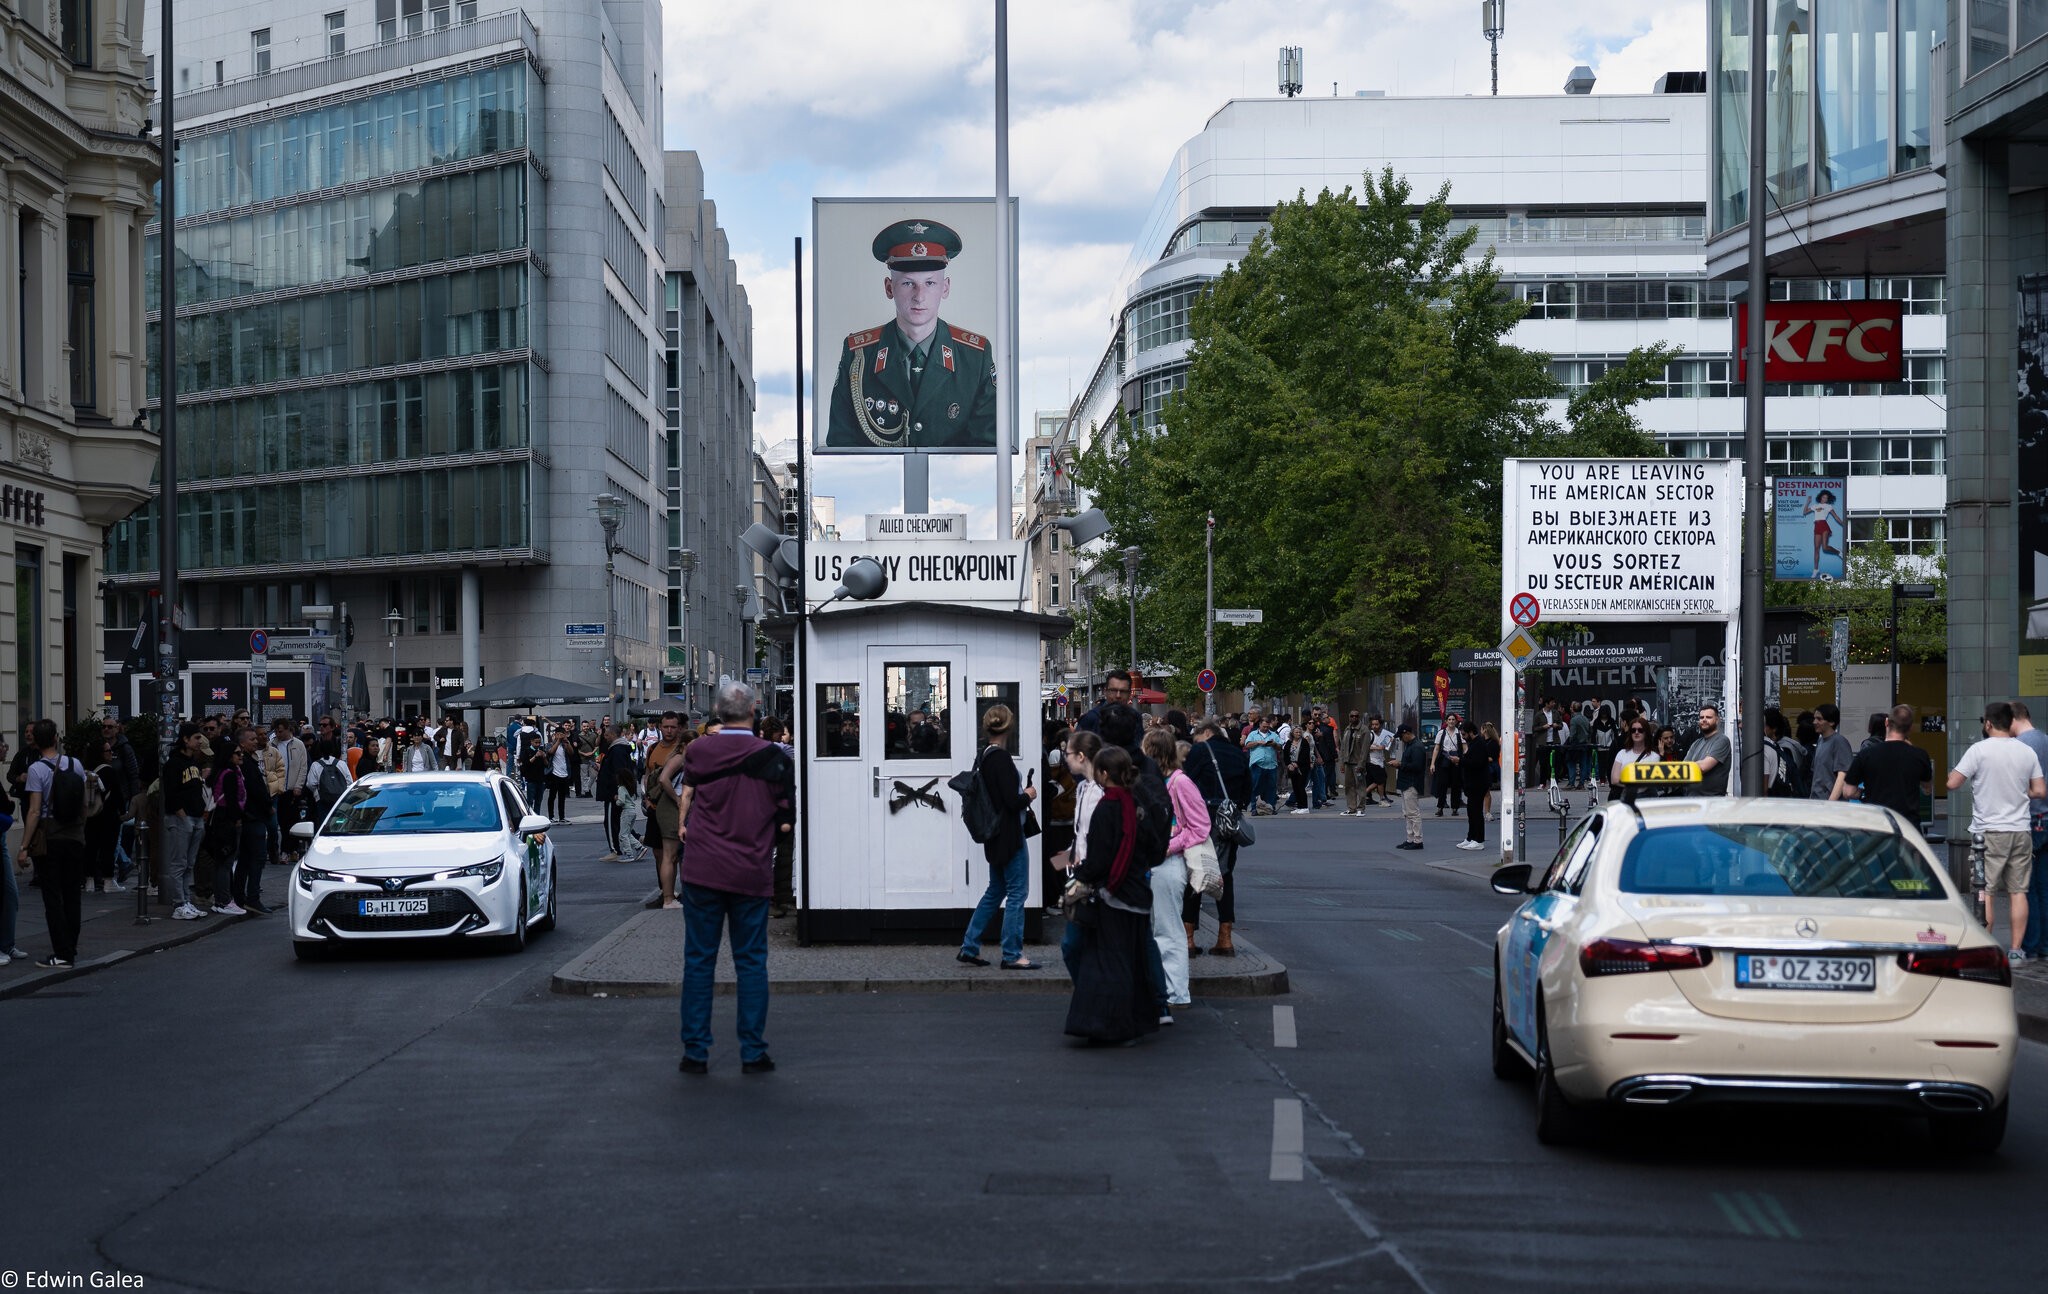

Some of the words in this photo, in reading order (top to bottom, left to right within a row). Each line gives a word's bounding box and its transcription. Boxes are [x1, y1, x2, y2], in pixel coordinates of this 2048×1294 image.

[1764, 318, 1894, 364] KFC
[1539, 464, 1574, 480] YOU
[1586, 464, 1620, 480] ARE
[1632, 464, 1705, 480] LEAVING
[1530, 484, 1557, 500] THE
[1565, 484, 1646, 500] AMERICAN
[1656, 484, 1715, 500] SECTOR
[1778, 481, 1842, 489] DESTINATION
[1777, 489, 1807, 497] STYLE
[0, 484, 45, 527] FFEE
[1532, 511, 1559, 526] ВЫ
[1570, 510, 1677, 526] ВЫЕЗЖАЕТЕ
[1689, 510, 1711, 526] ИЗ
[879, 518, 904, 534] ALLIED
[906, 518, 954, 533] CHECKPOINT
[1528, 530, 1648, 546] АМЕРИКАНСКОГО
[1654, 530, 1716, 546] СЕКТОРА
[908, 554, 1018, 582] CHECKPOINT
[1553, 553, 1602, 570] VOUS
[1613, 553, 1681, 570] SORTEZ
[1528, 575, 1548, 590] DU
[1554, 574, 1623, 590] SECTEUR
[1629, 572, 1715, 591] AMÉRICAIN
[1542, 599, 1589, 610] VERLASSEN
[1591, 599, 1607, 610] DEN
[1609, 599, 1681, 610] AMERIKANISCHEN
[1683, 599, 1714, 610] SEKTOR
[279, 641, 326, 650] Zimmerstraße
[1567, 648, 1605, 657] BLACKBOX
[1606, 647, 1626, 656] COLD
[1626, 647, 1644, 655] WAR
[1458, 660, 1494, 668] AUSSTELLUNG
[1536, 658, 1558, 666] CHARLIE
[1567, 656, 1596, 665] EXHIBITION
[1597, 656, 1605, 664] AT
[1605, 656, 1636, 664] CHECKPOINT
[1636, 655, 1662, 663] CHARLIE
[441, 678, 460, 687] COFFEE
[1637, 765, 1688, 779] TAXI
[366, 902, 374, 912] B
[381, 901, 395, 912] HI
[398, 900, 426, 912] 7025
[1751, 959, 1766, 979] B
[1782, 959, 1810, 981] OZ
[1816, 960, 1871, 982] 3399
